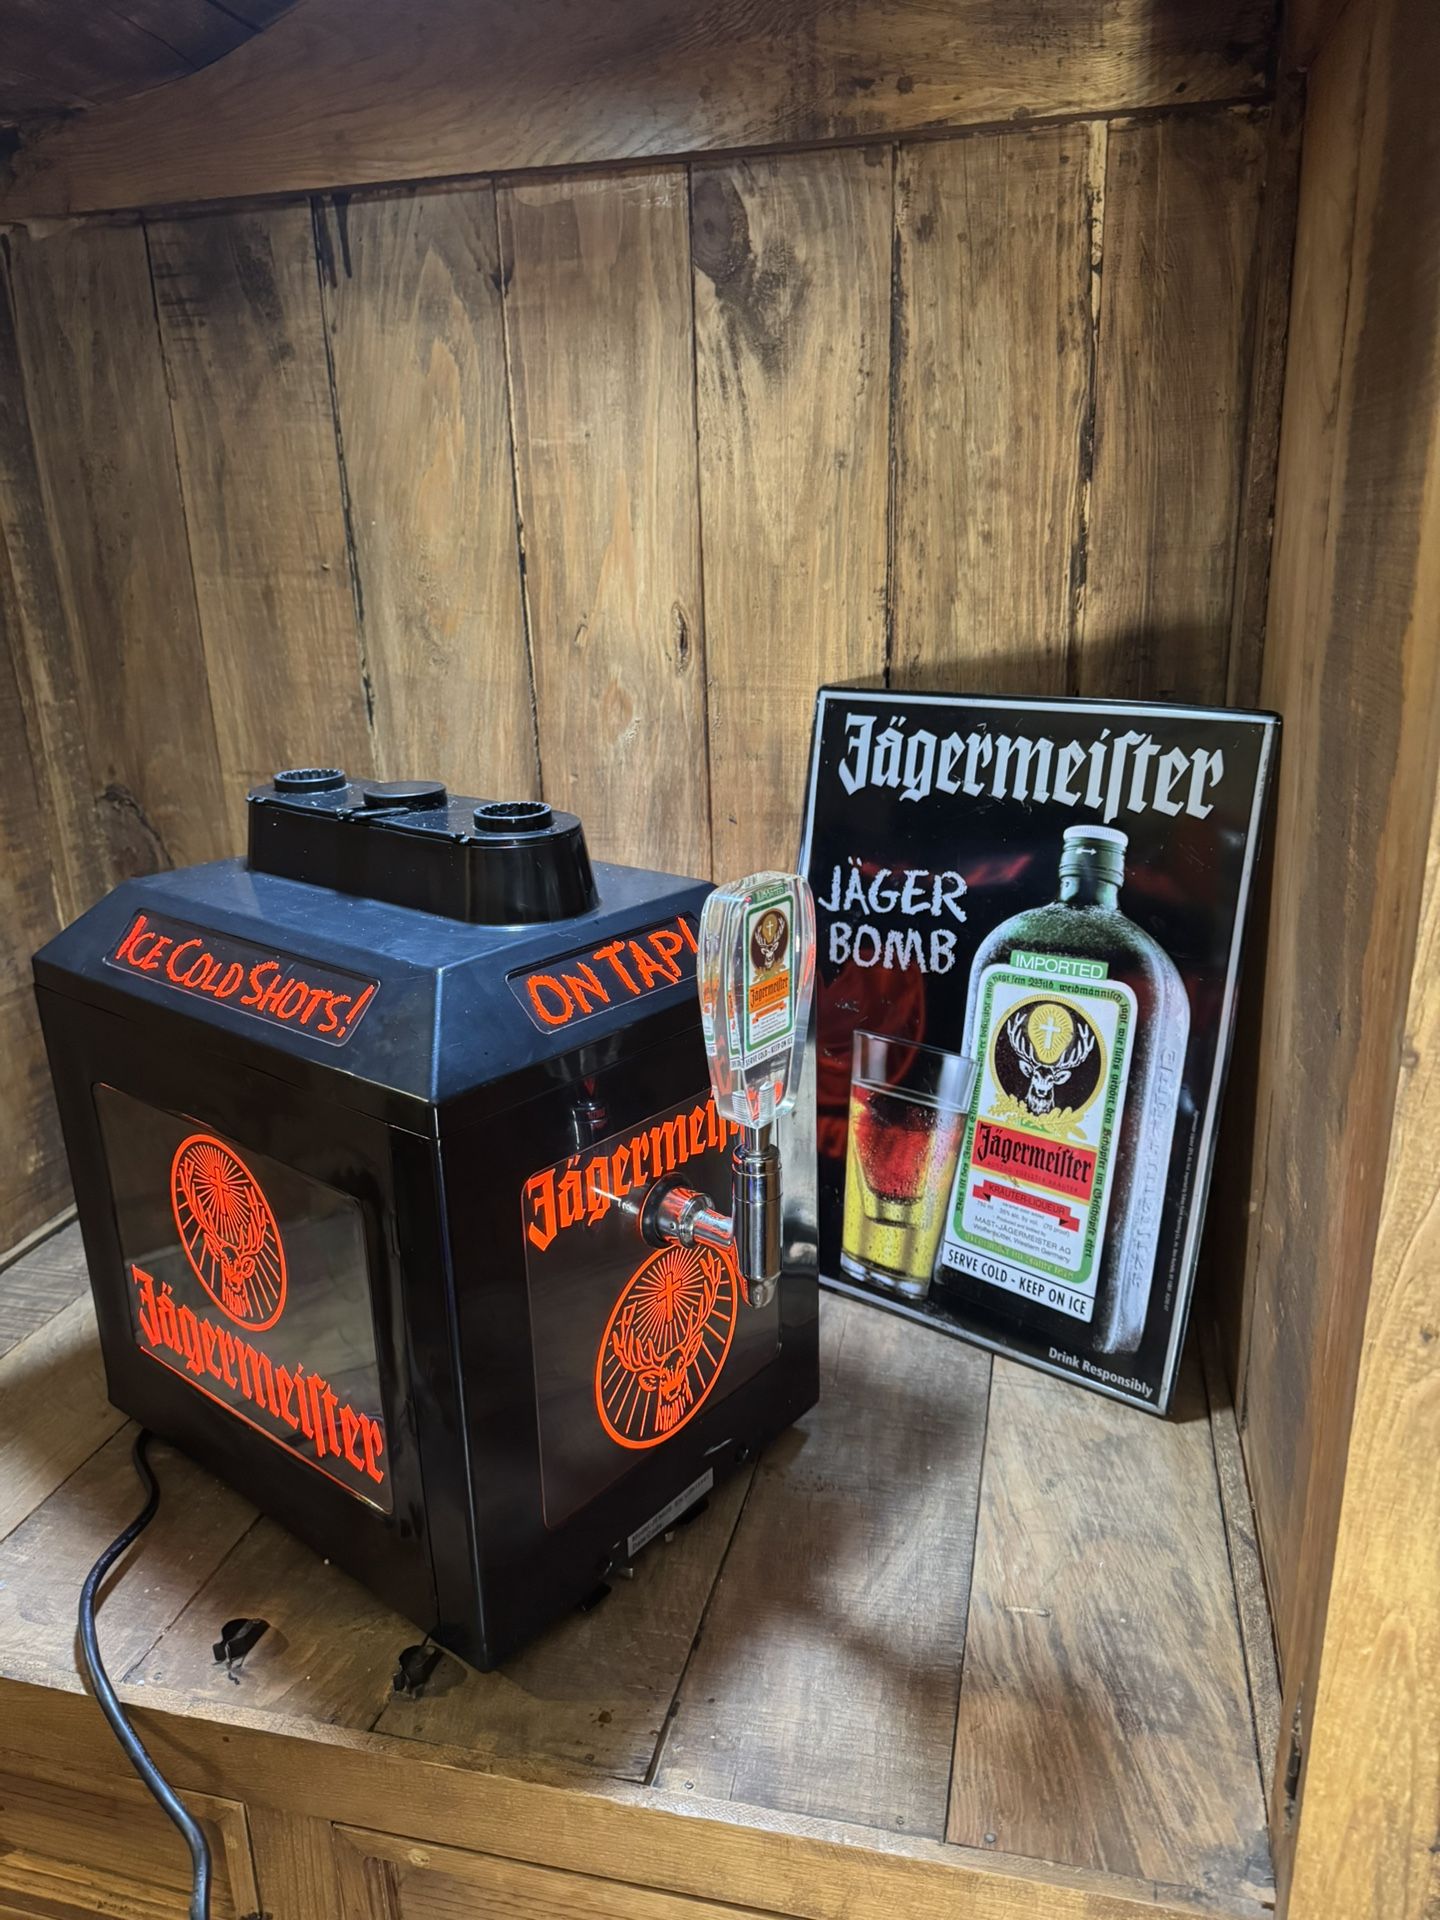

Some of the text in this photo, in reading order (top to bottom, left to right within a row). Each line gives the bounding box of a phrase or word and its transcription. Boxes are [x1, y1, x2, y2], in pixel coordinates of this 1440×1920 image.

[839, 712, 1225, 824] Jägermeister
[818, 857, 968, 923] JÄGER
[116, 915, 375, 1038] ICE COLD SHOTS!
[828, 921, 959, 975] BOMB
[1015, 953, 1104, 981] IMPORTED
[525, 960, 612, 1027] ON
[526, 1087, 741, 1252] Jägermei
[977, 1123, 1091, 1184] Jägermeister
[948, 1249, 979, 1272] SERVE
[981, 1261, 1008, 1284] COLD
[1018, 1276, 1046, 1299] KEEP
[1047, 1288, 1066, 1308] ON
[1068, 1296, 1087, 1315] ICE
[132, 1263, 386, 1485] Jägermeister
[1048, 1346, 1153, 1398] Drink Responsibly
